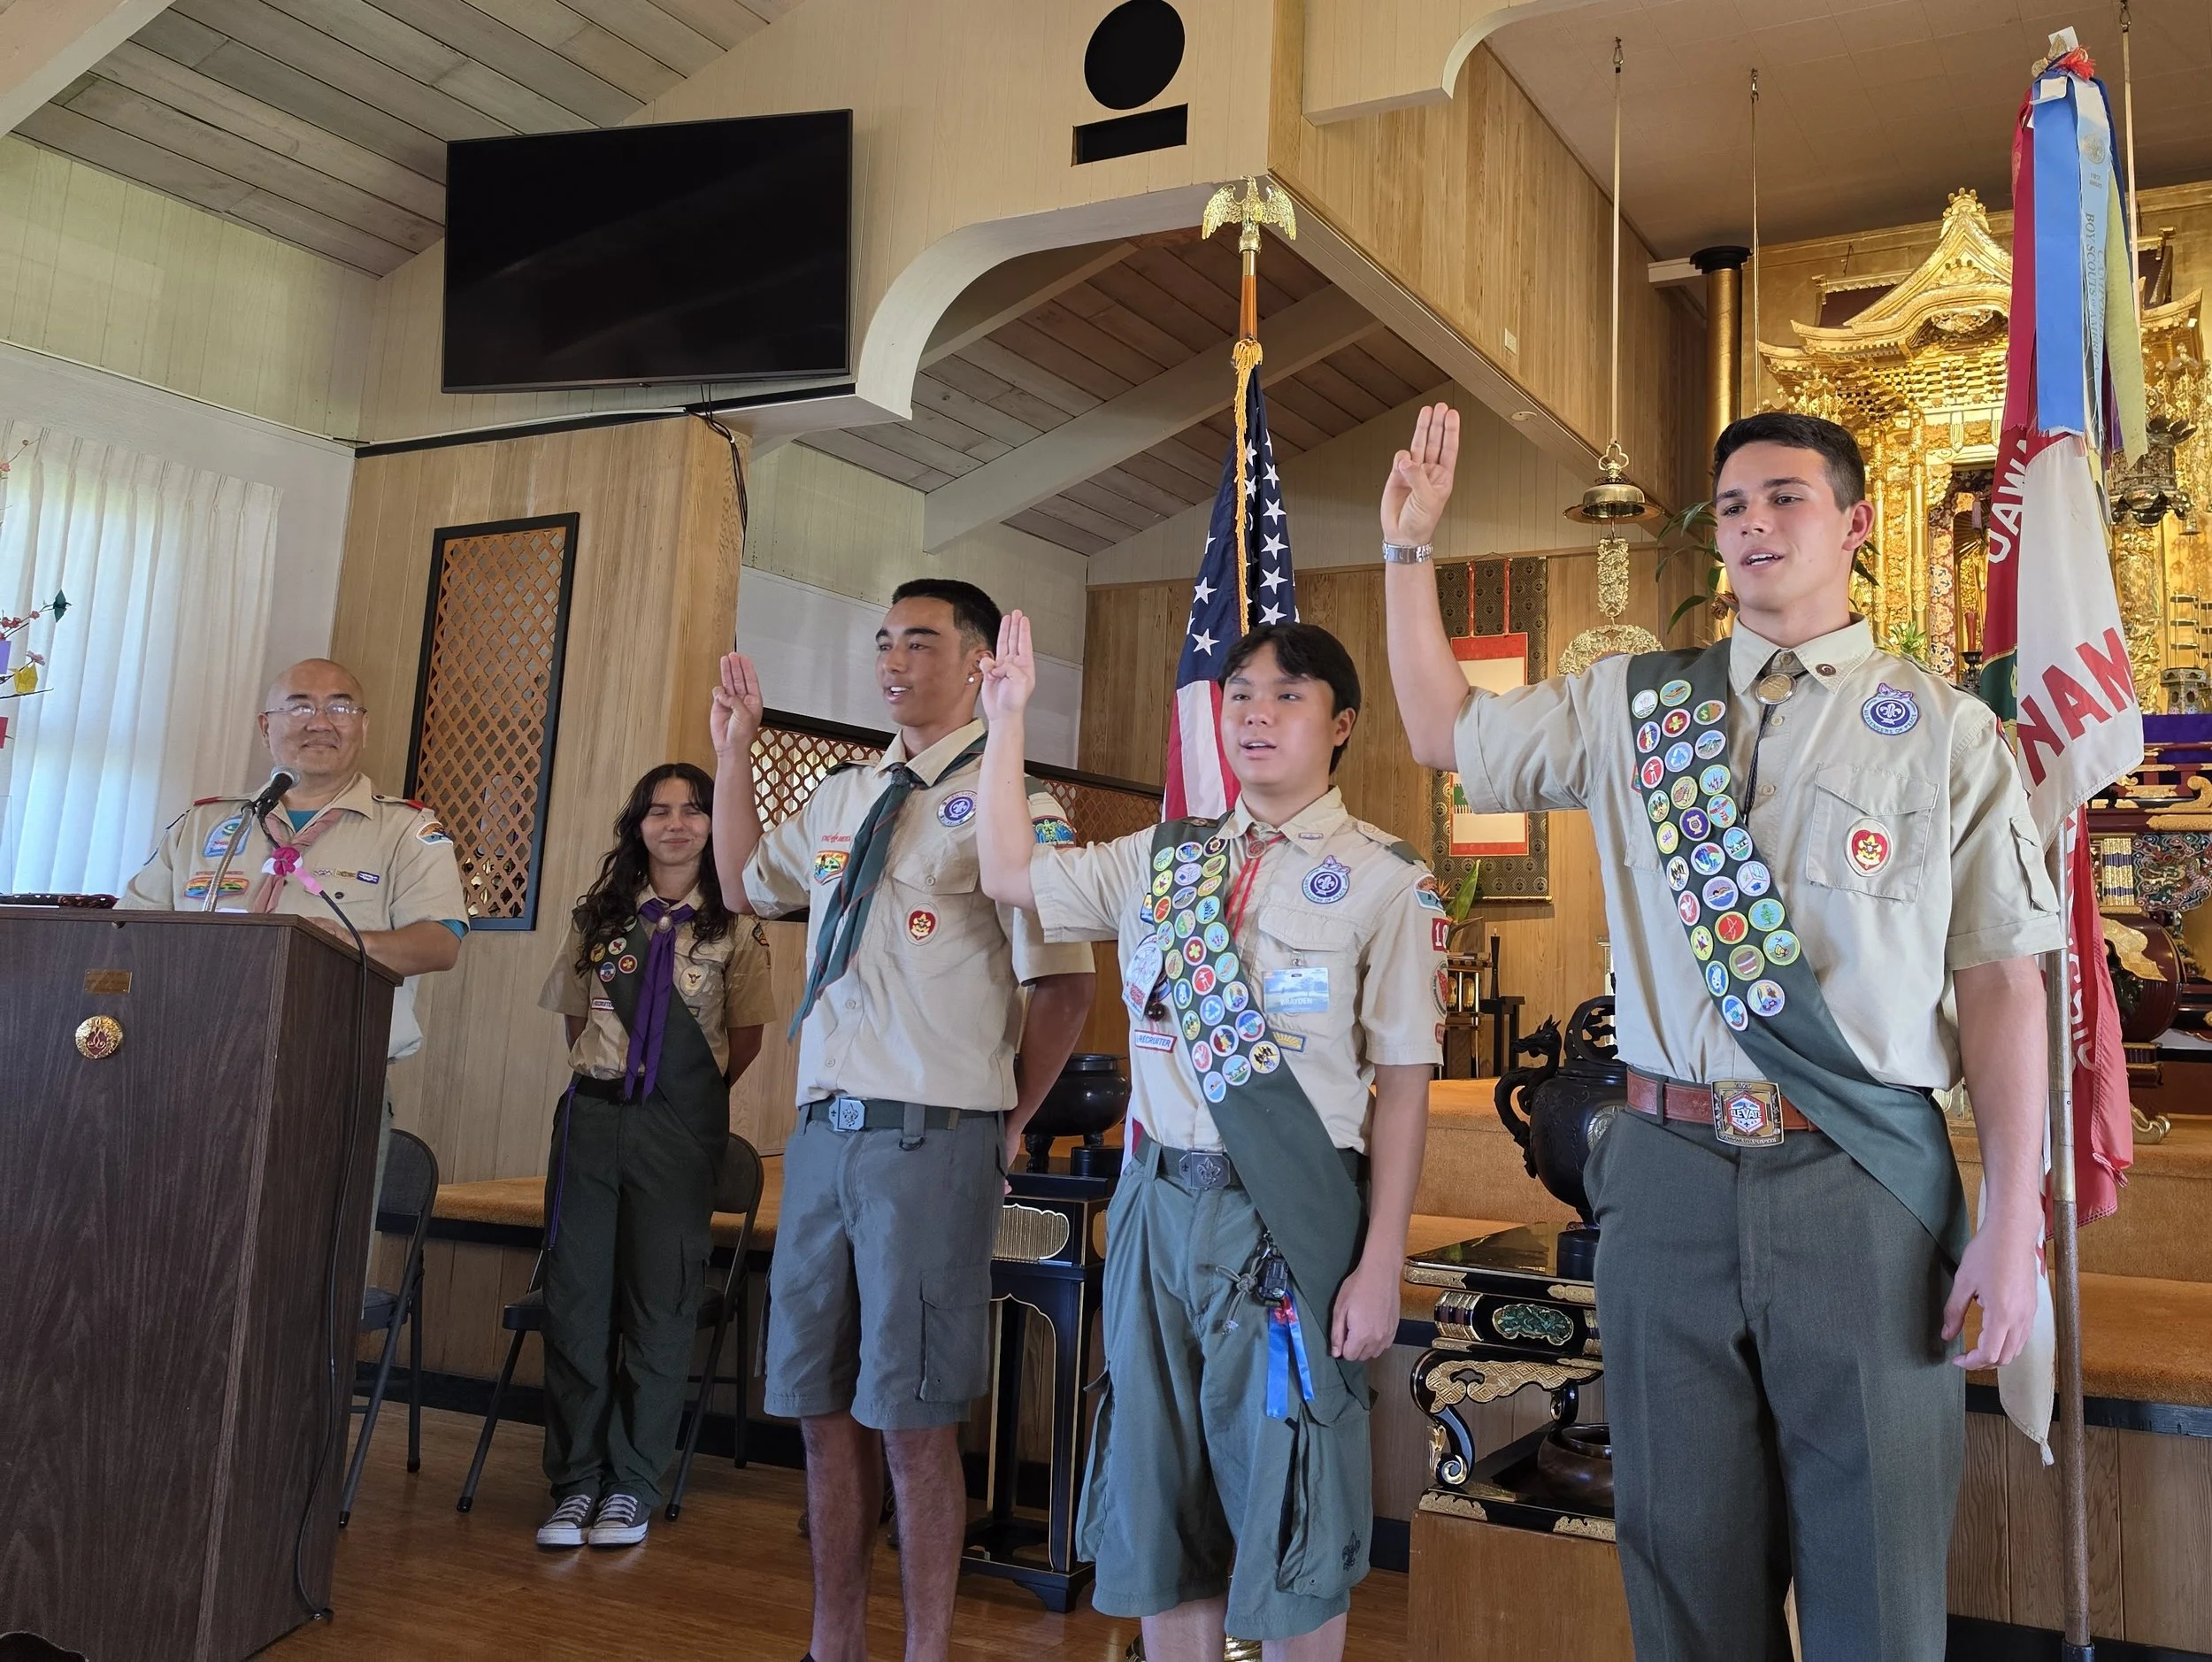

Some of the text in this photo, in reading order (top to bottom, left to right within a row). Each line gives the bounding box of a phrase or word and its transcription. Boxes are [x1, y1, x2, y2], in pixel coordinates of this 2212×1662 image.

[2085, 213, 2095, 243] BOY
[2086, 244, 2096, 295] SCOUTS
[1280, 997, 1313, 1006] BRAYDEN
[1731, 1108, 1762, 1120] ELEVATE
